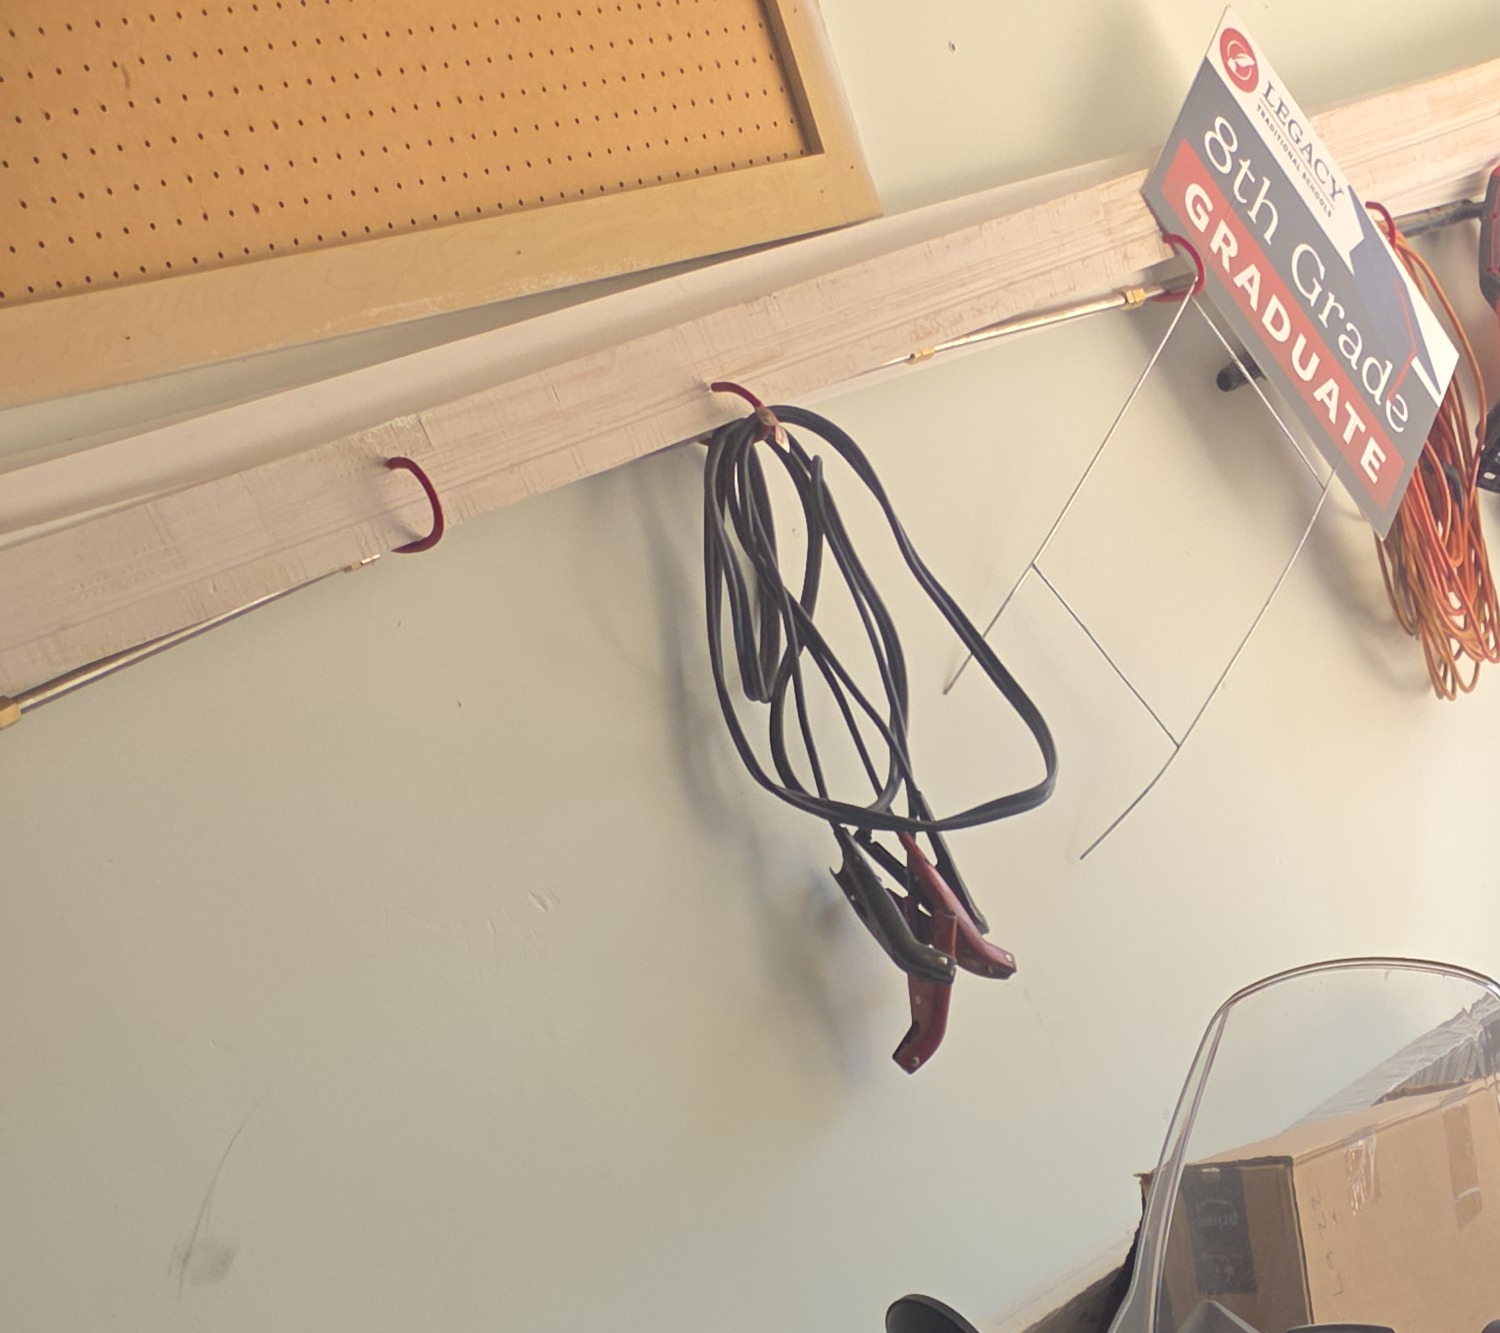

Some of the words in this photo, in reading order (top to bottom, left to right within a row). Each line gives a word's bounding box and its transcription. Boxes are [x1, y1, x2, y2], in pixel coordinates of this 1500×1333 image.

[1256, 103, 1300, 172] TRADITIONAL
[1301, 171, 1333, 218] SCHOOLS
[1262, 81, 1344, 199] LEGACY
[1184, 183, 1387, 484] GRADUATE
[1204, 116, 1279, 246] 8th
[1291, 243, 1409, 433] Grade
